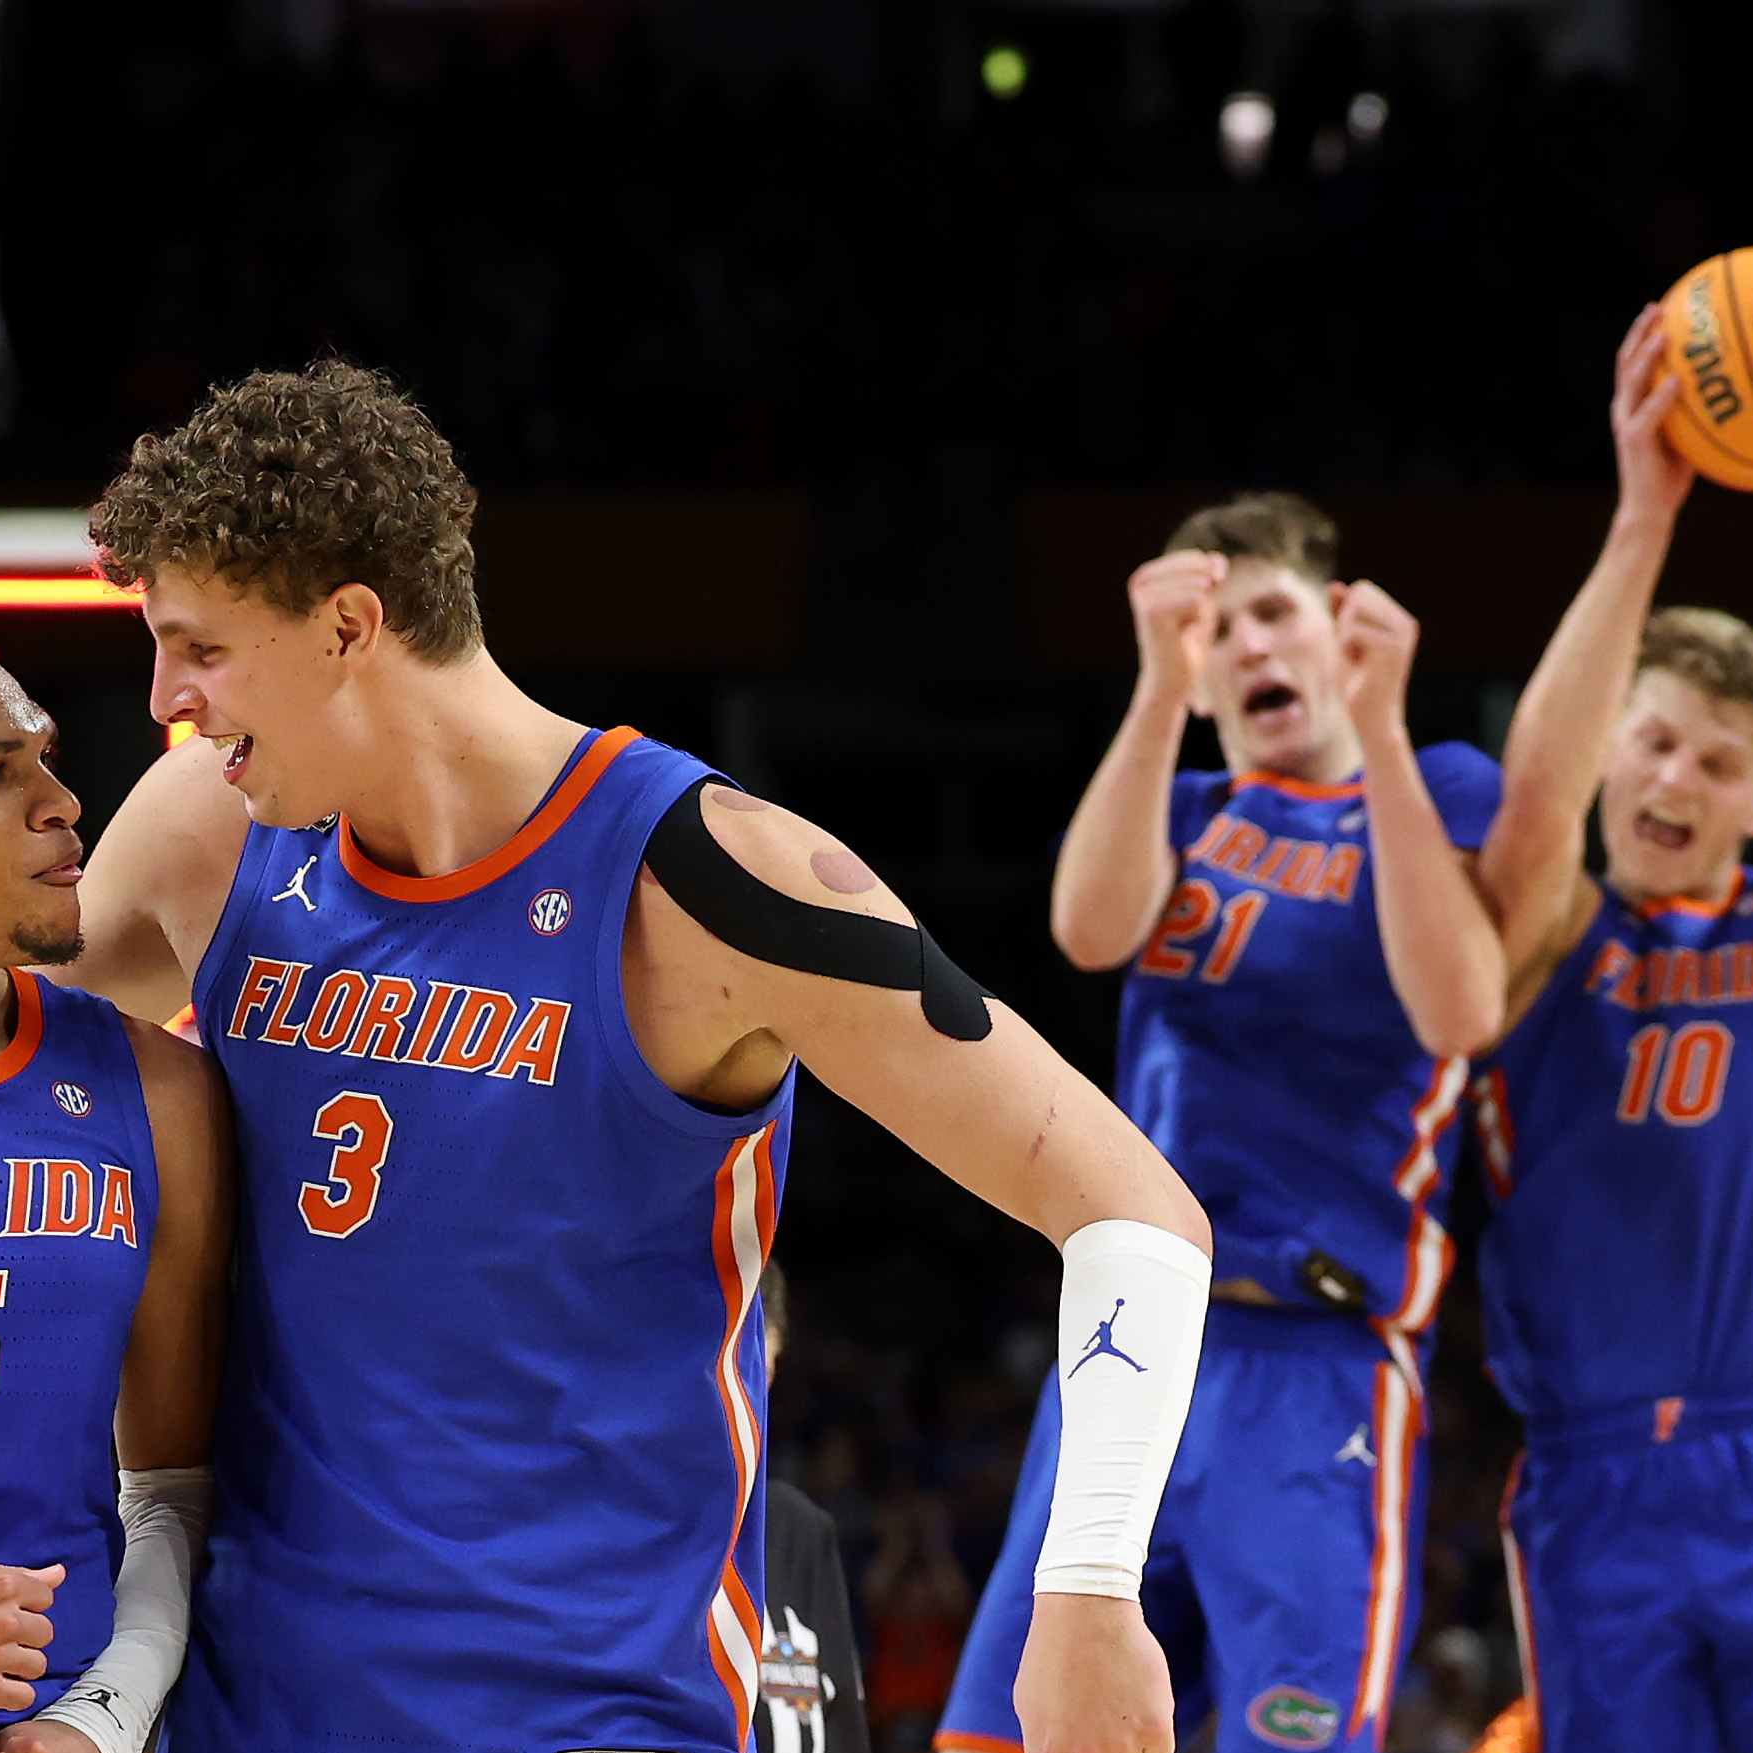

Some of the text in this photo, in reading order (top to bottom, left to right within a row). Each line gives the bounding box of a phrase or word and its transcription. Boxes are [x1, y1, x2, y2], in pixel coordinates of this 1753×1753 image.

[532, 893, 568, 931] SEC
[1185, 812, 1364, 907] RIDA
[1136, 877, 1269, 985] 21
[227, 955, 572, 1086] FLORIDA
[1616, 1020, 1735, 1128] 10
[55, 1083, 89, 1114] SEC
[297, 1090, 394, 1239] 3
